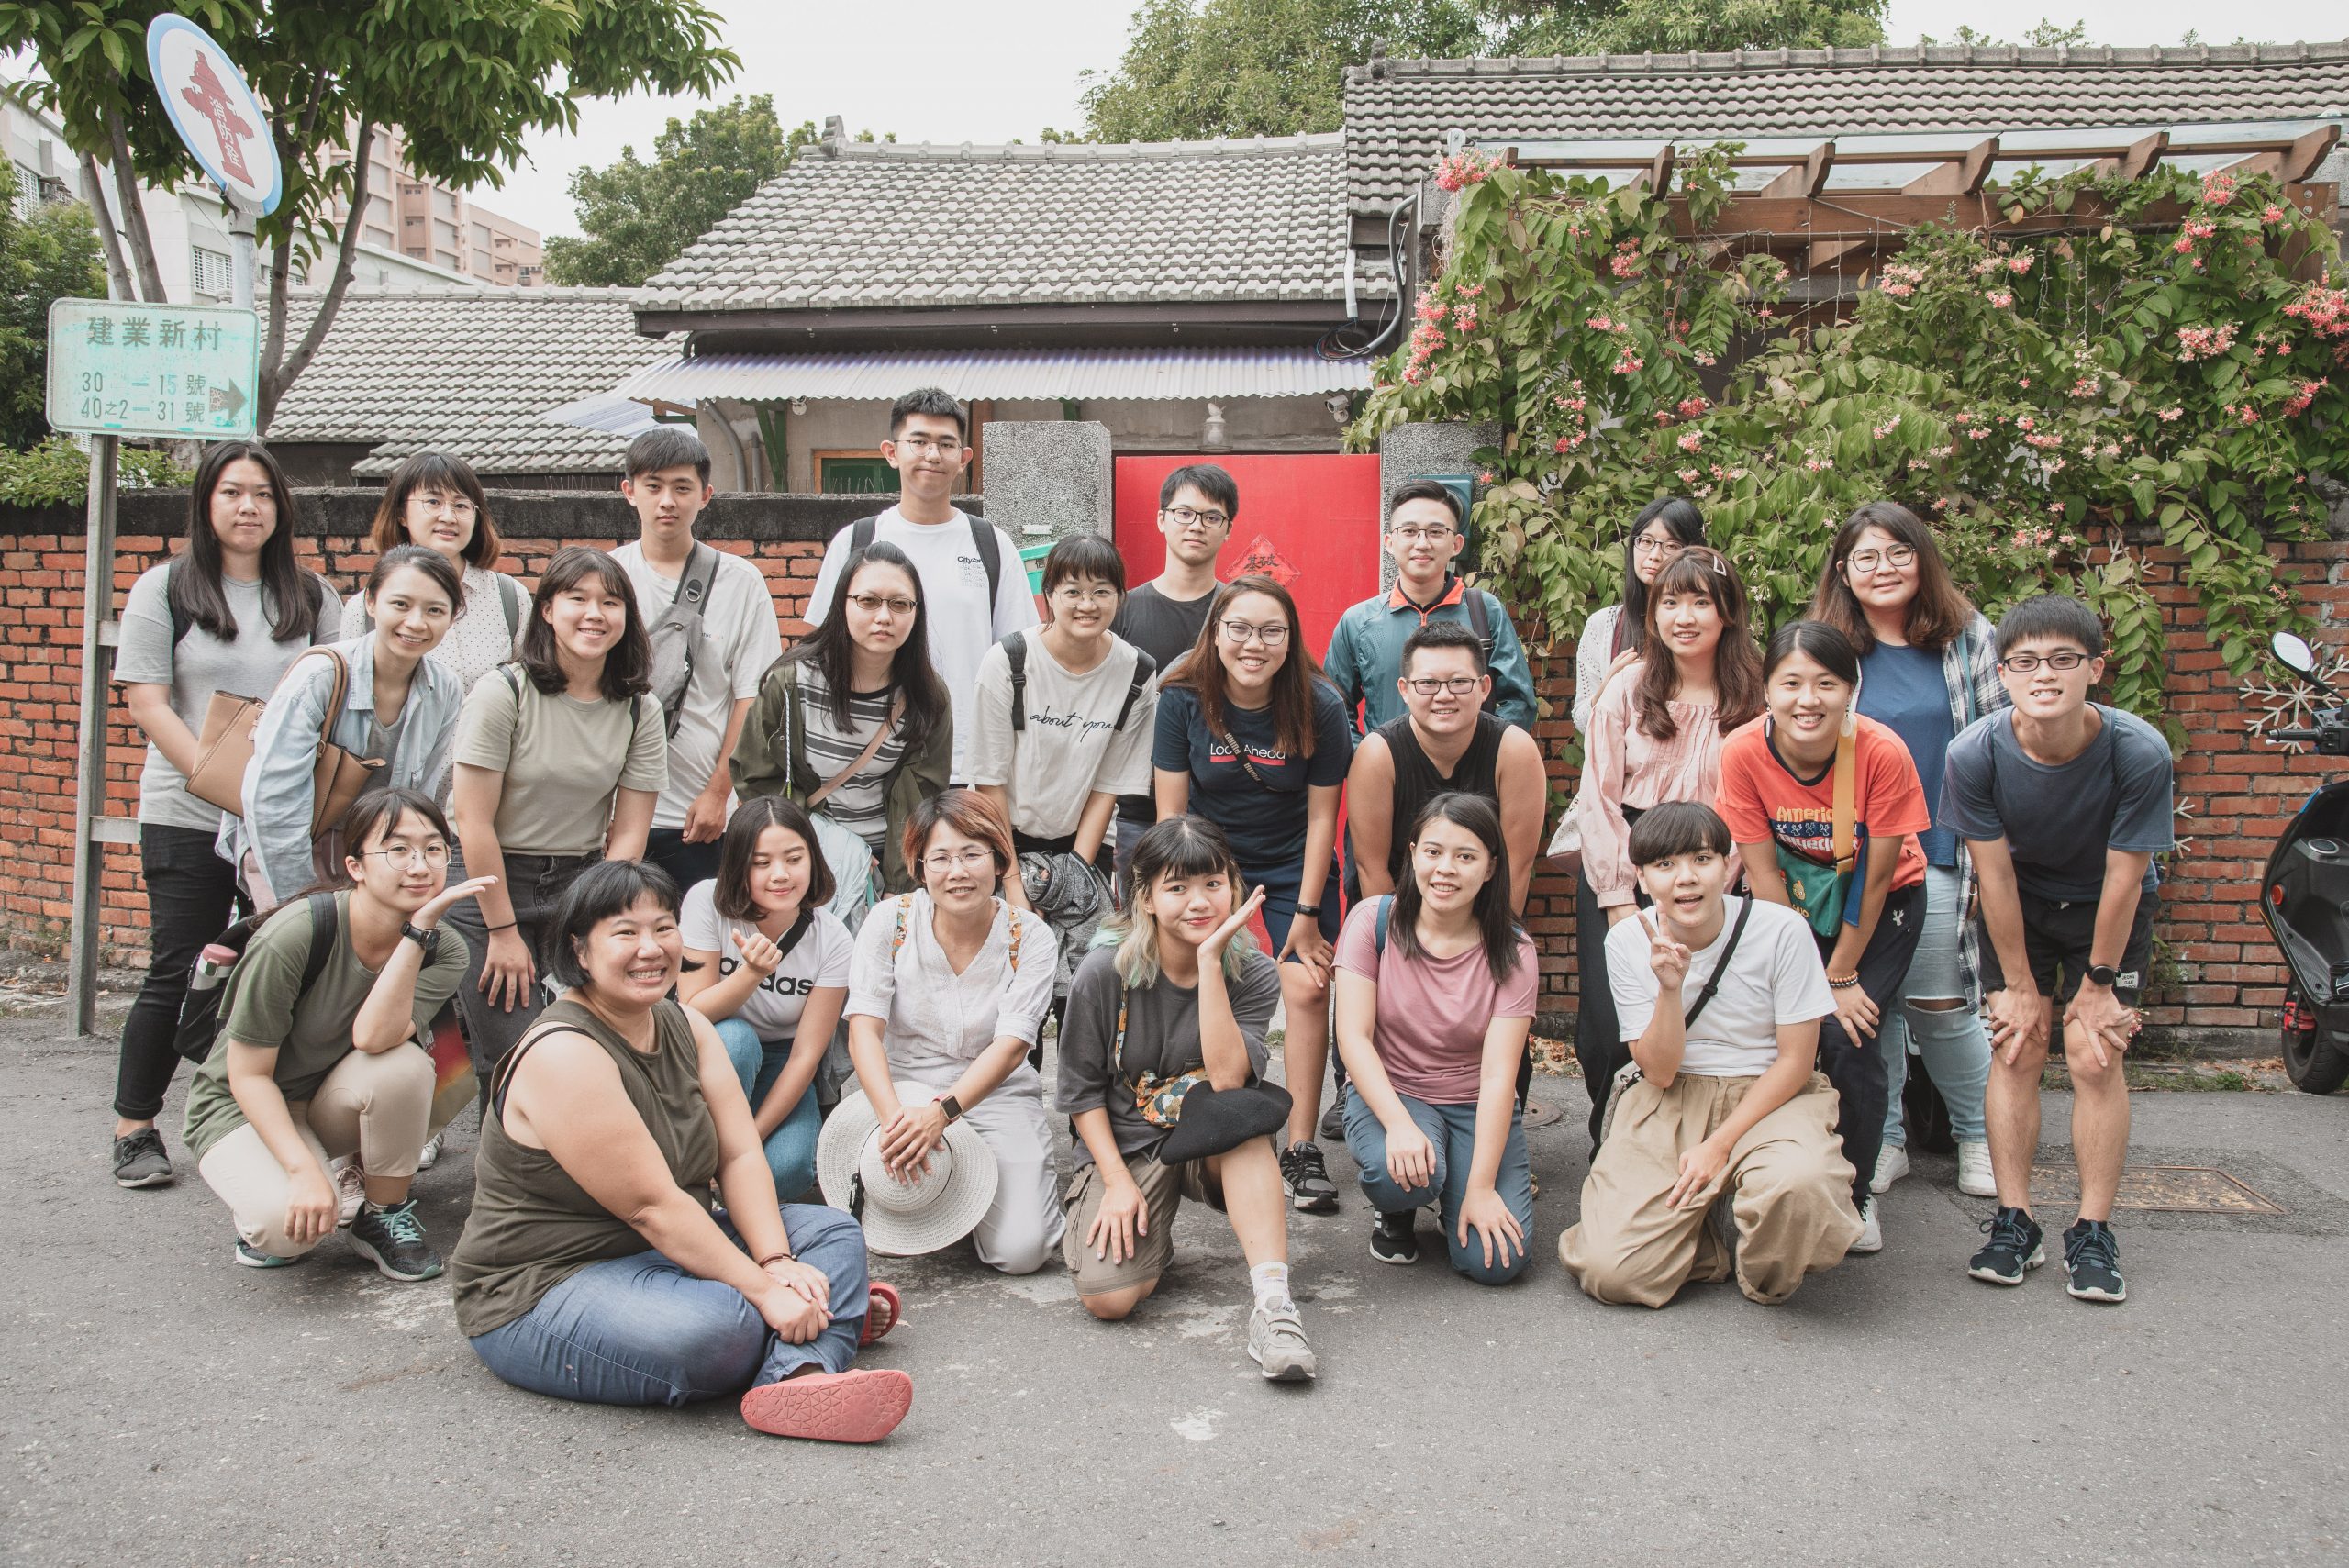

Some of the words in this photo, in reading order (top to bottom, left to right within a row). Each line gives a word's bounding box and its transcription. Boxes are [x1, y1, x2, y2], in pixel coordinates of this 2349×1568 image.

[86, 316, 222, 351] 建業新村
[82, 371, 104, 393] 30
[160, 374, 177, 395] 15
[157, 400, 175, 421] 31
[1029, 705, 1084, 728] about
